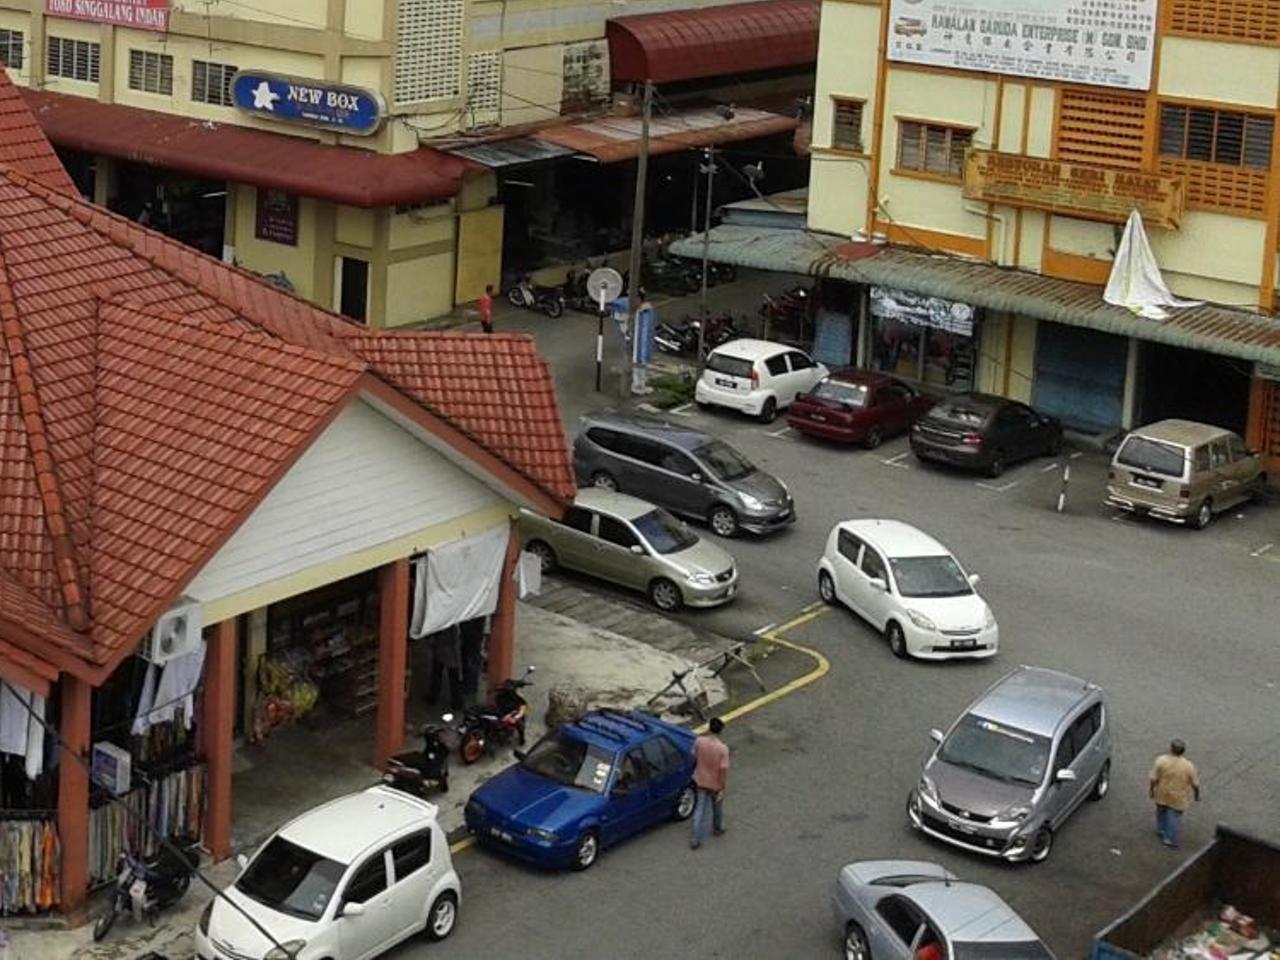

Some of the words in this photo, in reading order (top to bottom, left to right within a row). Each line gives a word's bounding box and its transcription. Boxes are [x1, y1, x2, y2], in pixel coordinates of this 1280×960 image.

[1022, 23, 1080, 44] ENTERPRISE
[287, 84, 323, 105] NEW
[326, 91, 360, 112] BOX
